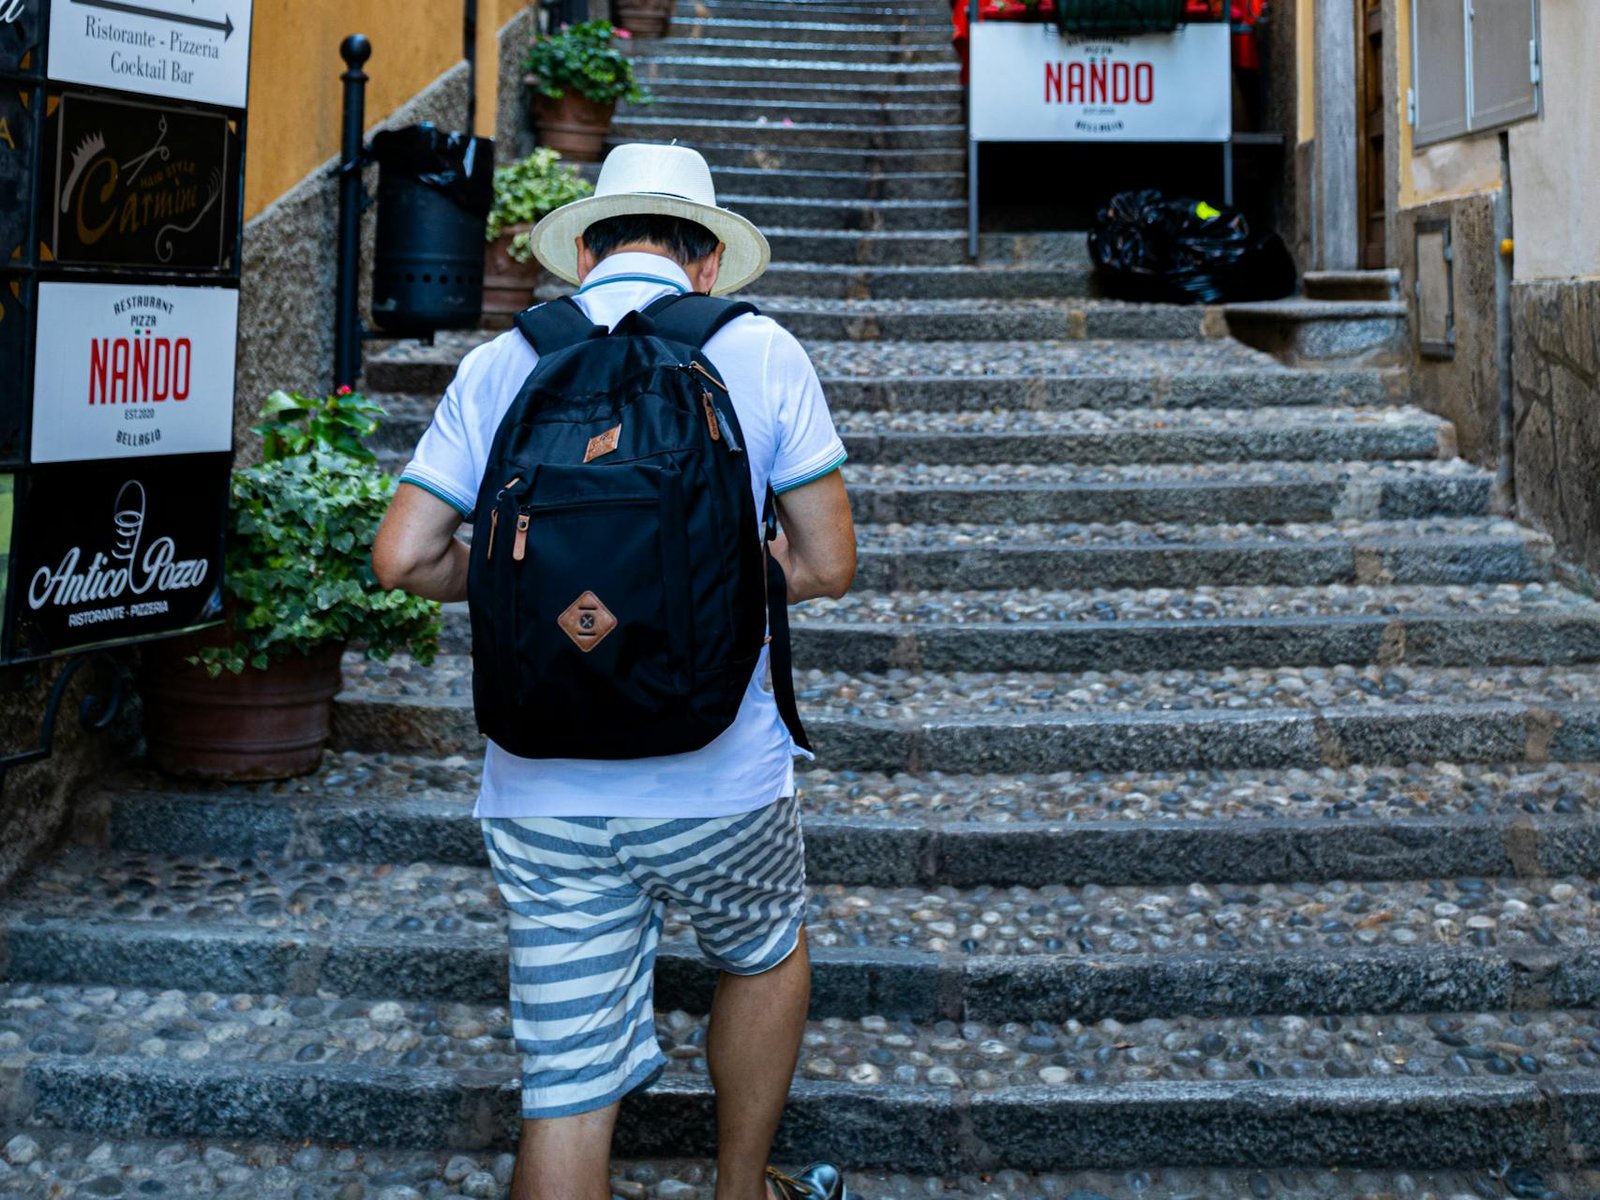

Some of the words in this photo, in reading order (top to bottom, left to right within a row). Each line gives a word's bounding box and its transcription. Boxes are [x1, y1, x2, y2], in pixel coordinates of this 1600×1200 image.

[85, 14, 155, 48] Ristorante
[169, 30, 219, 59] Pizzeria
[110, 51, 166, 80] Cocktail
[171, 61, 194, 85] Bar
[113, 295, 175, 316] RESTAURANT
[130, 315, 157, 327] PIZZA
[115, 428, 162, 447] BELLAGIO
[28, 546, 129, 610] Antico
[132, 536, 208, 594] Pozzo
[68, 605, 125, 627] RISTORANTE
[130, 599, 168, 618] PIZZERIA
